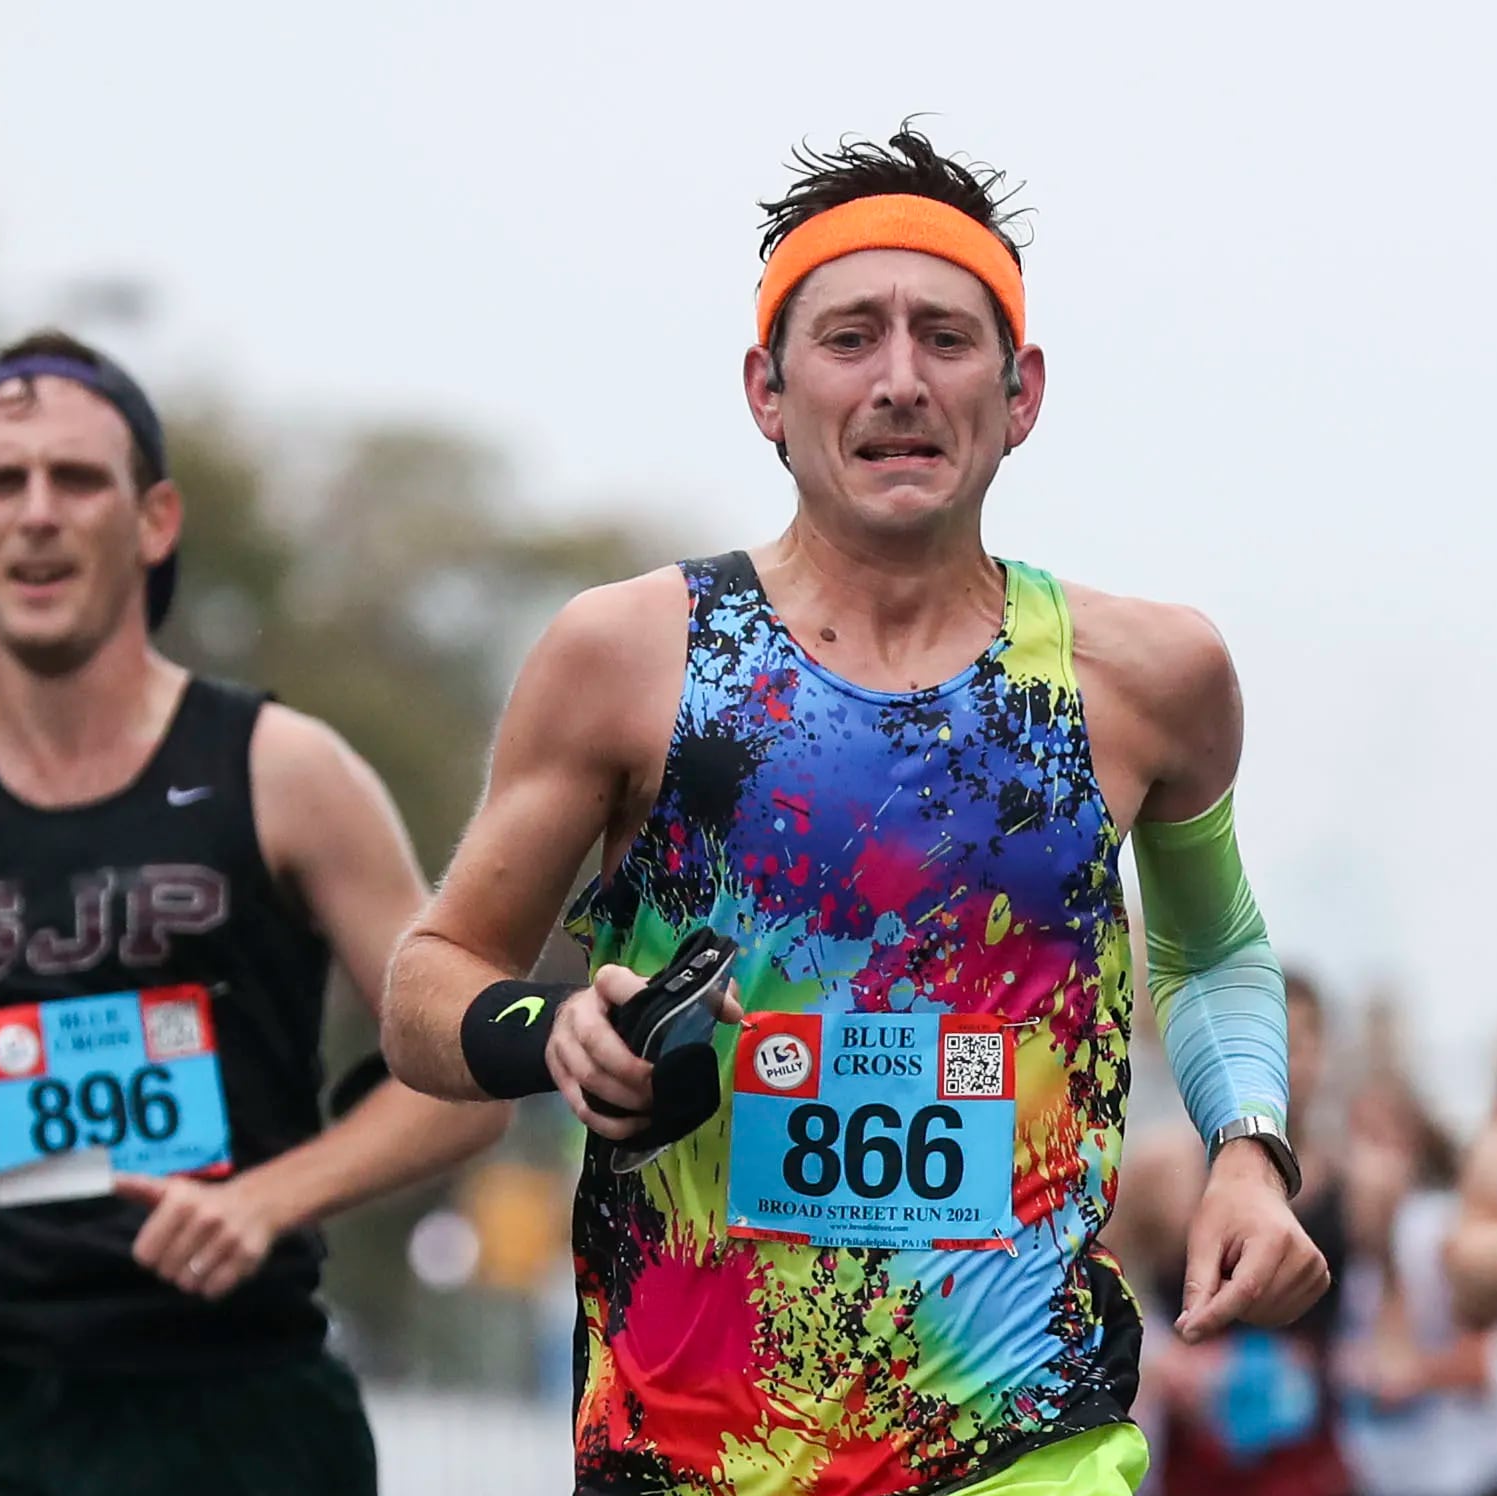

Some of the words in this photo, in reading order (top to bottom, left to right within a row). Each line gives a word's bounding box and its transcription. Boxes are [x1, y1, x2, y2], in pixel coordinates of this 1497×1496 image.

[842, 1026, 916, 1049] BLUE
[766, 1061, 803, 1079] PHILLY
[833, 1053, 923, 1077] CROSS
[27, 1063, 179, 1155] 896
[782, 1102, 965, 1201] 866
[758, 1198, 822, 1218] BROAD
[826, 1205, 898, 1221] STREET
[903, 1206, 941, 1221] RUN
[946, 1207, 981, 1222] 2021
